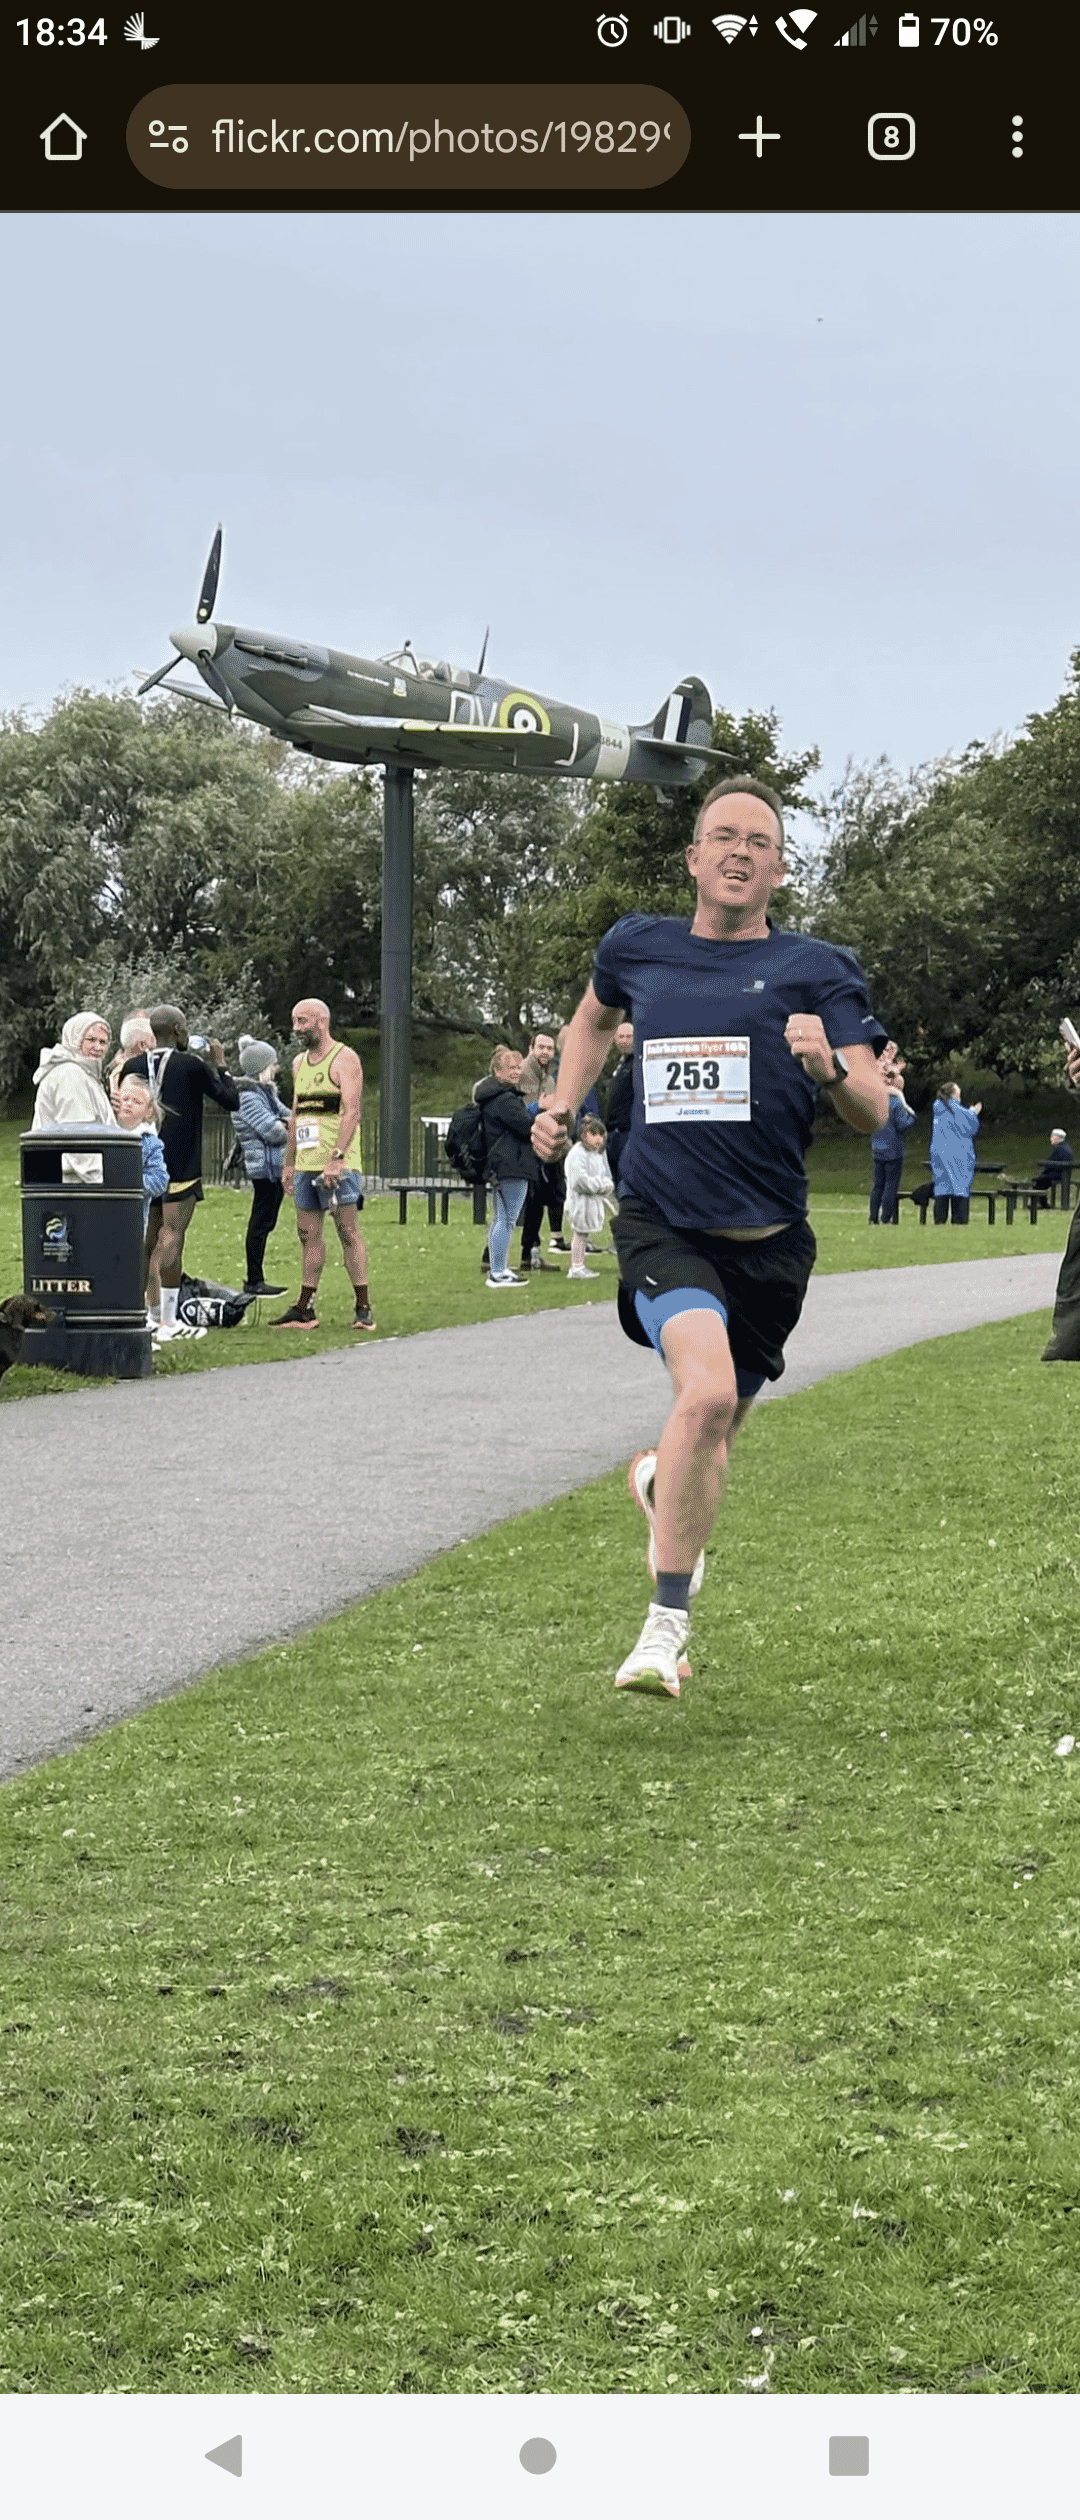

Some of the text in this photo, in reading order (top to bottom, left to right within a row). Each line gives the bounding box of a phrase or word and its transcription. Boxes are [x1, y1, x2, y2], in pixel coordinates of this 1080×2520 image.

[16, 17, 108, 47] 18:34
[930, 17, 999, 47] 70%
[883, 125, 900, 149] 8
[666, 1061, 720, 1091] 253
[32, 1278, 92, 1293] LITTER
